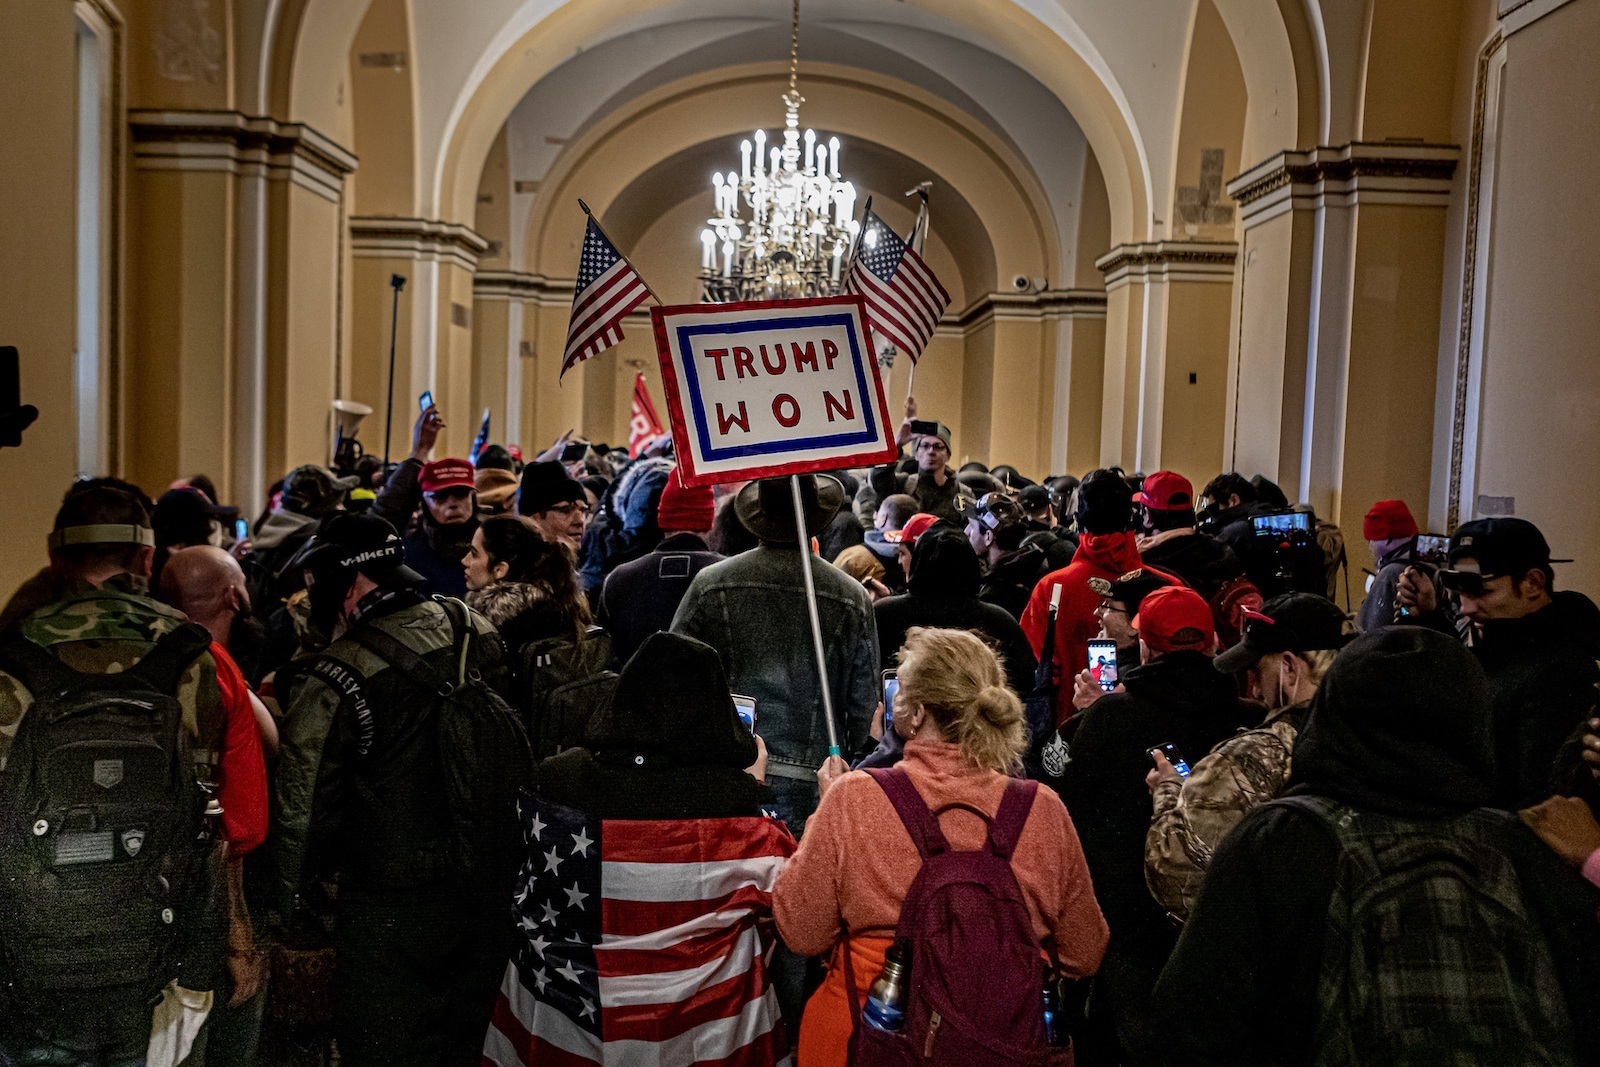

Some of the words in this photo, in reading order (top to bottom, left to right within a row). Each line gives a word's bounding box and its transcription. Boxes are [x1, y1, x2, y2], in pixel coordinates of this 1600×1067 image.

[703, 338, 840, 381] TRUMP
[715, 388, 856, 436] WON
[314, 659, 374, 755] HARLEY-DAVIDSO
